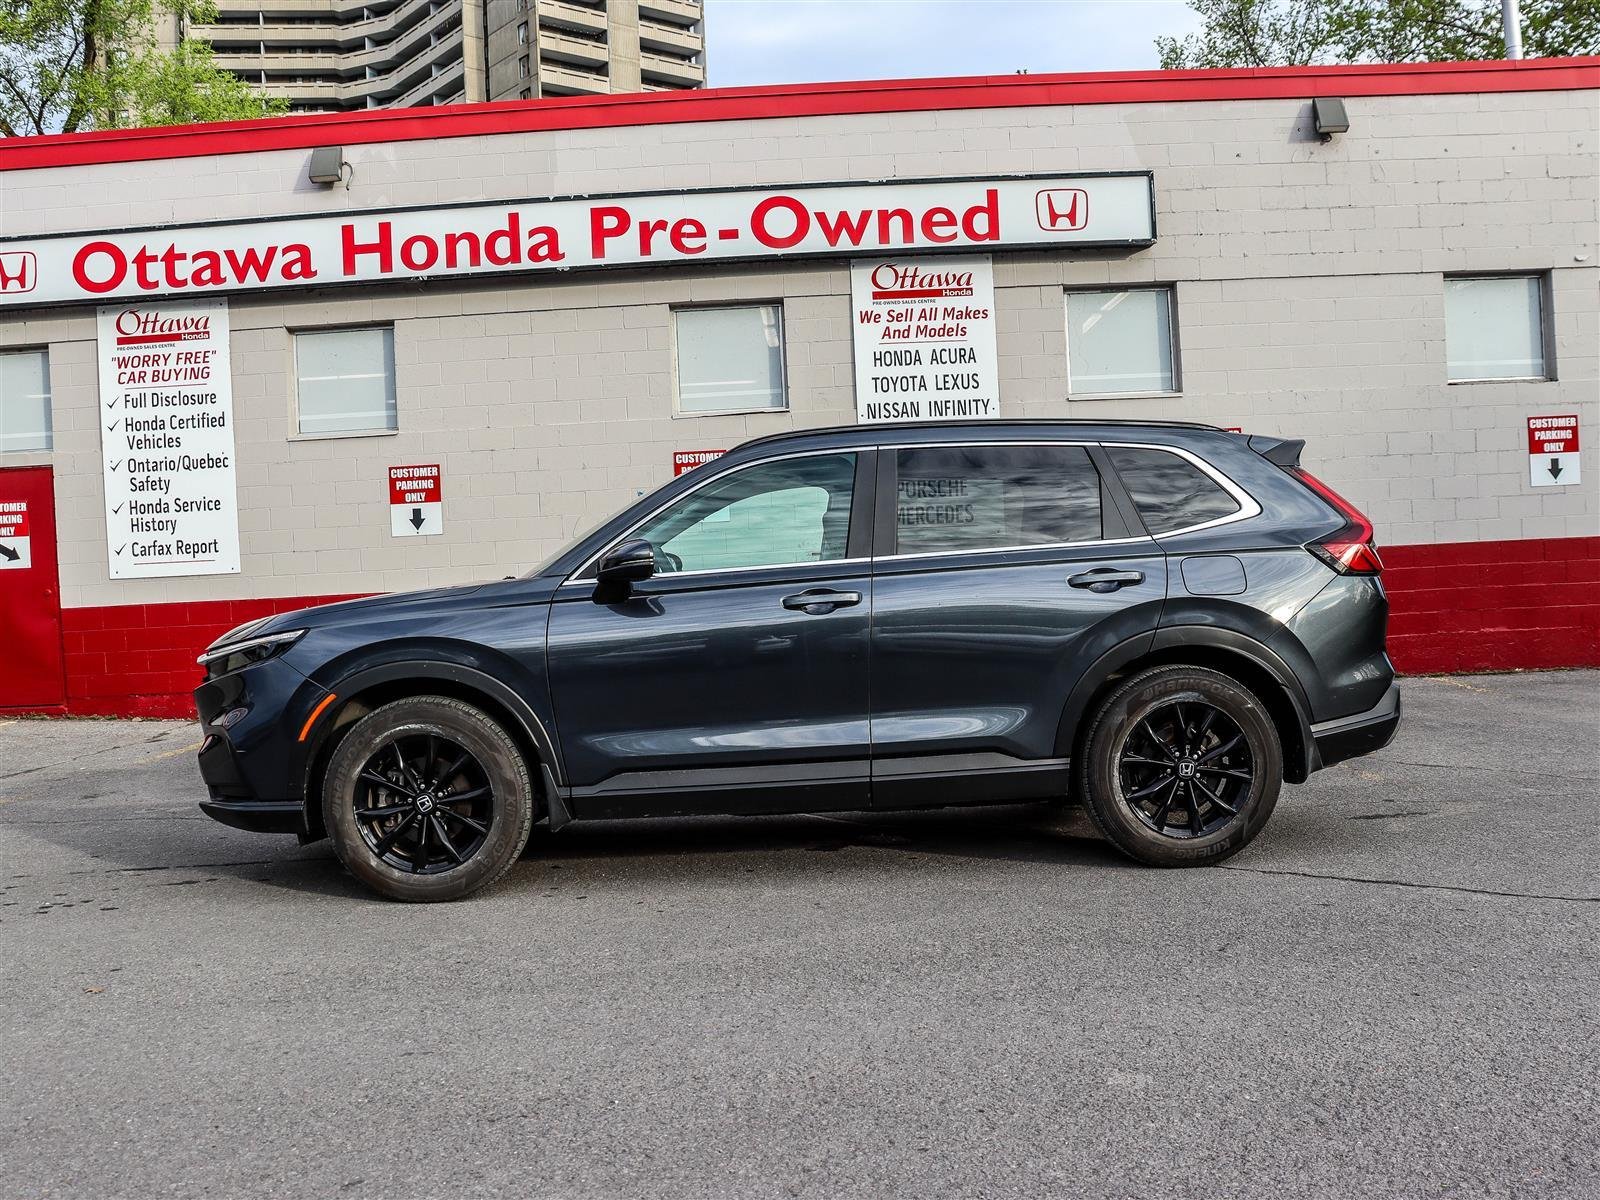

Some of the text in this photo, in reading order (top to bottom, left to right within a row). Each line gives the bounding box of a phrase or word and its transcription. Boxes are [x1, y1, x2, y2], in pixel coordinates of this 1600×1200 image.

[72, 189, 1001, 293] Ottawa Honda Pre-Owned
[871, 263, 973, 290] Ottawa
[942, 289, 972, 297] Honda
[116, 309, 210, 335] Ottawa
[859, 306, 988, 324] We Sell All Makes
[181, 332, 209, 341] Honda
[881, 323, 967, 339] And Models
[111, 350, 217, 369] "WORRY FREE"
[873, 347, 977, 367] HONDA ACURA
[117, 367, 211, 385] CAR BUYING
[872, 373, 980, 393] TOYOTA LEXUS
[124, 391, 217, 409] Full Disclosure
[867, 398, 991, 420] NISSAN INFINITY
[125, 411, 226, 432] Honda Certified
[1529, 417, 1576, 429] CUSTOMER
[127, 433, 181, 450] Vehicles
[1534, 429, 1573, 441] PARKING
[1543, 442, 1565, 452] ONLY
[127, 453, 229, 473] Ontario/Quebec
[390, 466, 438, 479] CUSTOMER
[130, 475, 171, 495] Safety
[395, 479, 434, 491] PARKING
[129, 496, 221, 515] Honda Service
[404, 492, 426, 502] ONLY
[0, 502, 27, 512] TOMER
[0, 526, 15, 536] NLY
[131, 518, 177, 535] History
[131, 539, 219, 558] Carfax Report
